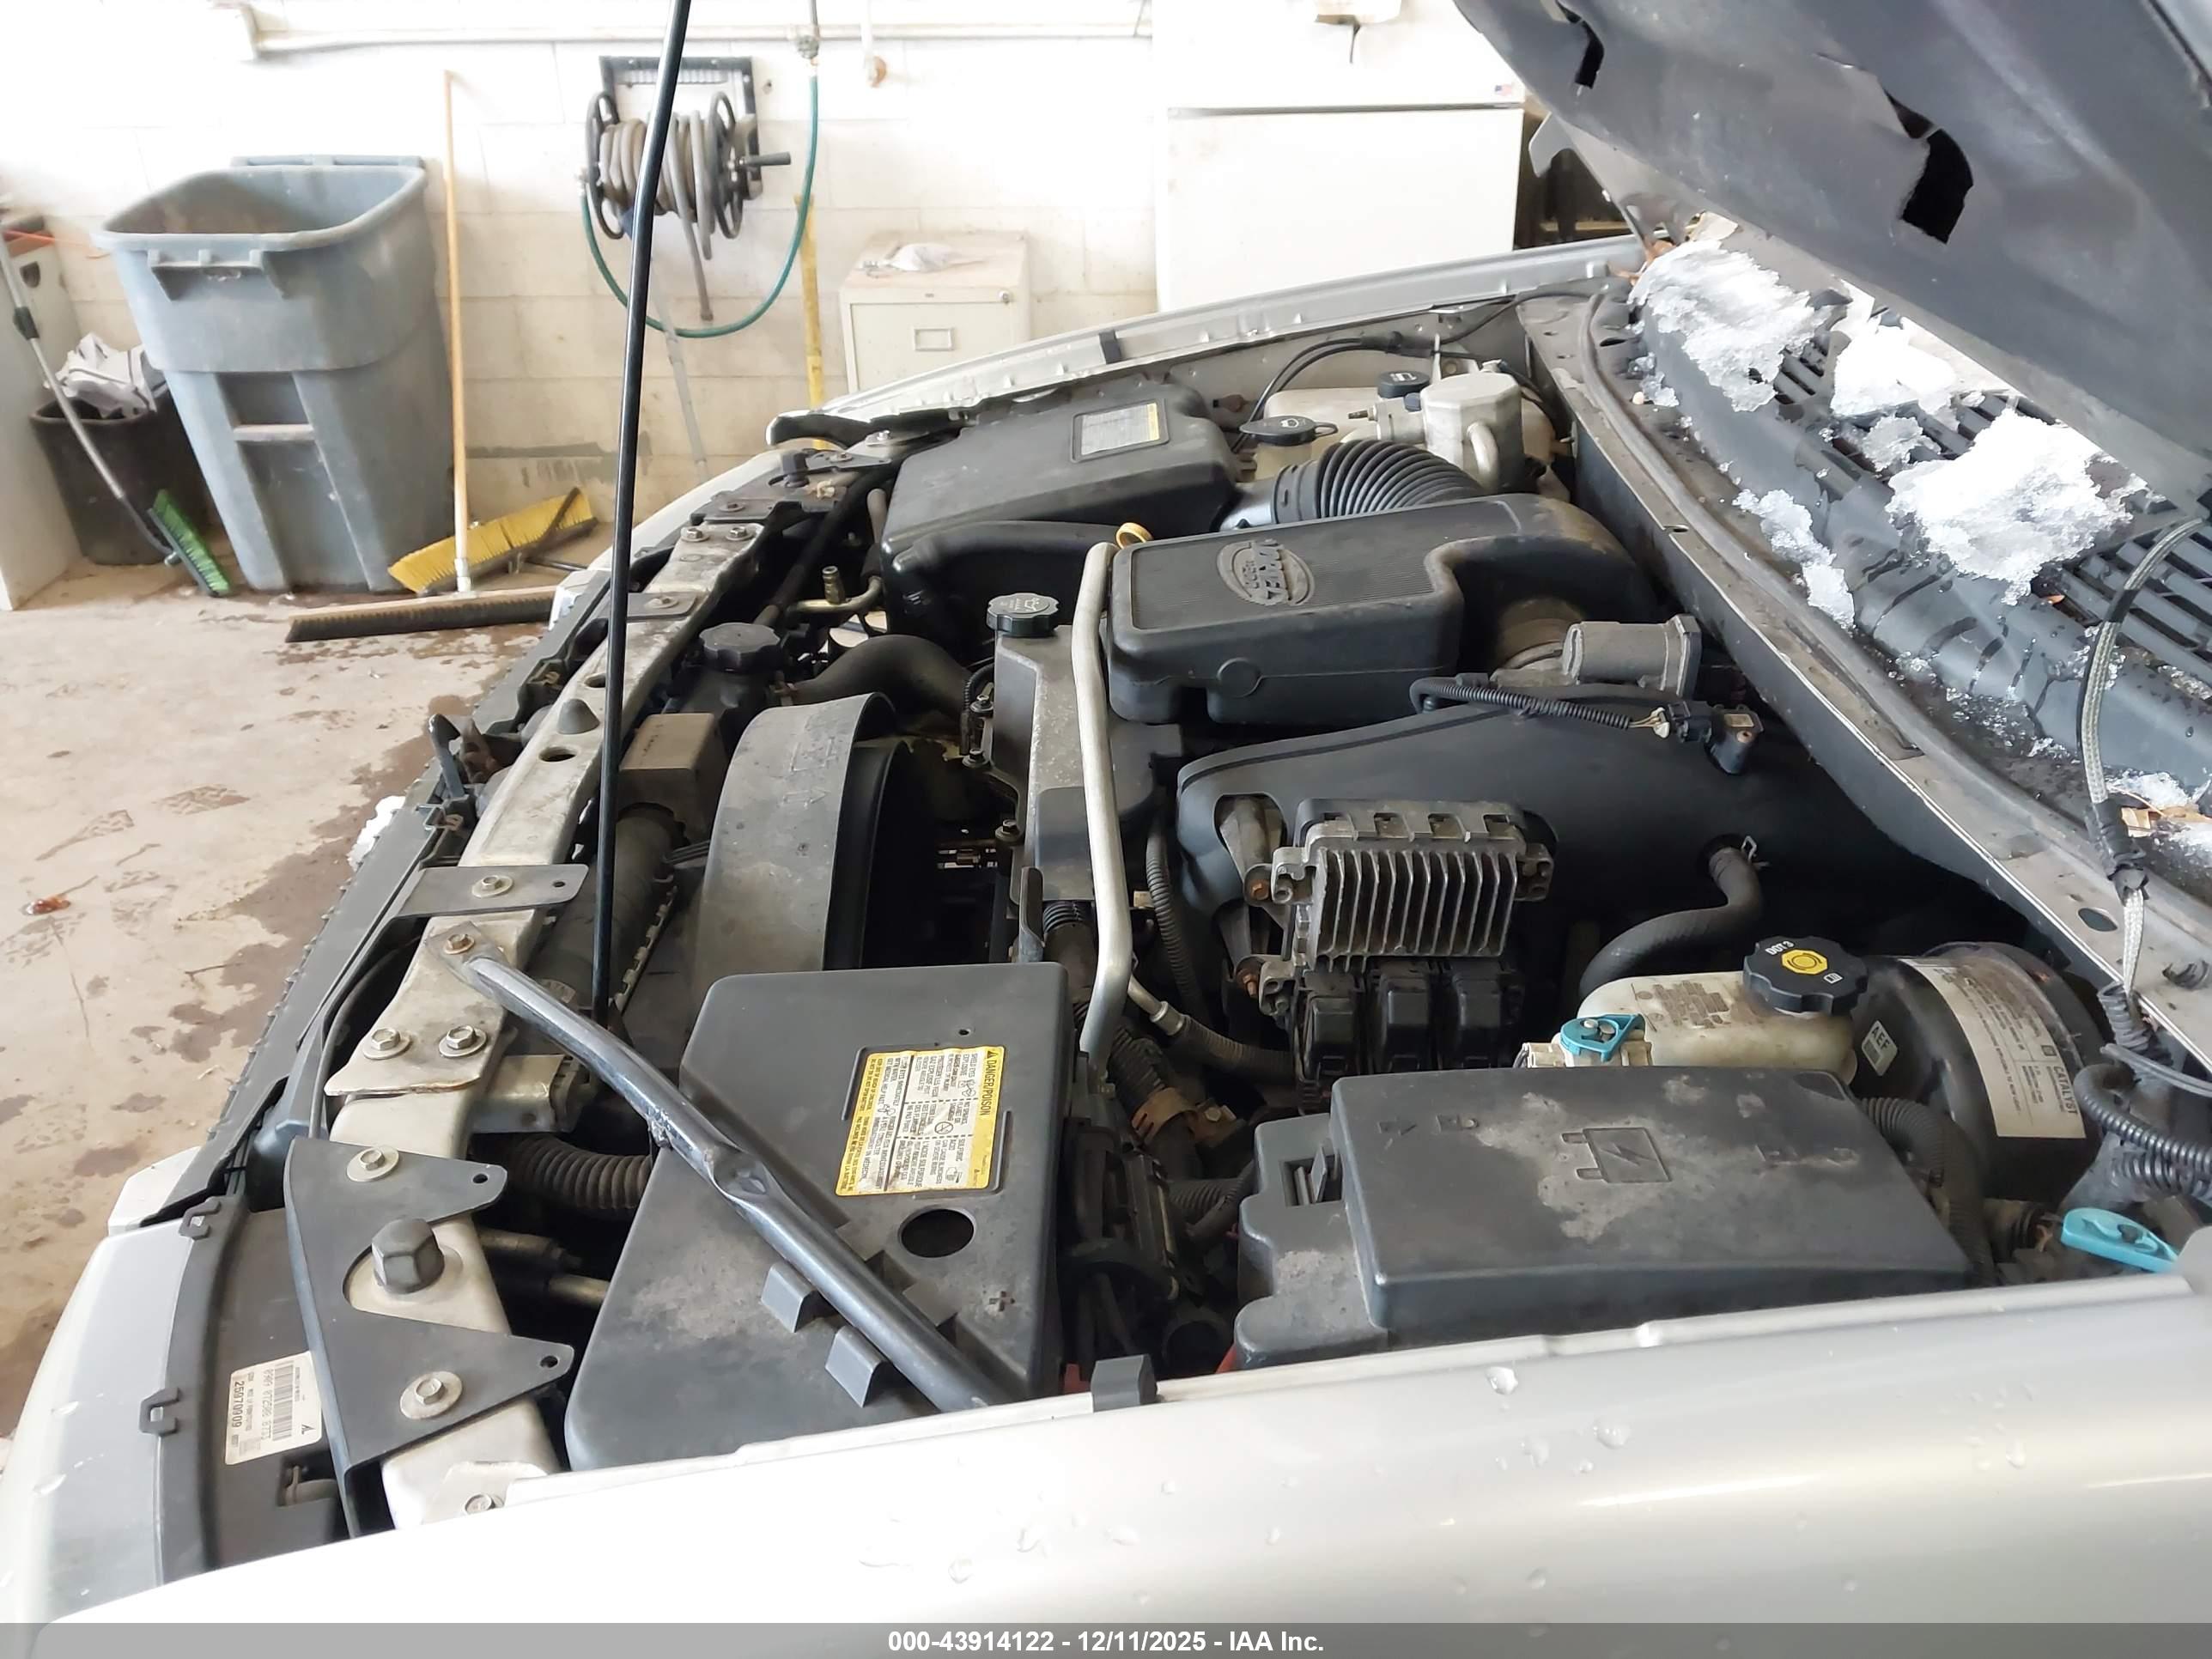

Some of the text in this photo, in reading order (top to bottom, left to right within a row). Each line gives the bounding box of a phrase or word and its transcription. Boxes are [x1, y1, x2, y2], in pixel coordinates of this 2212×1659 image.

[1872, 1026, 1890, 1049] AEF
[979, 1059, 997, 1115] DANGER/POISON
[2054, 1066, 2078, 1115] CATALYST
